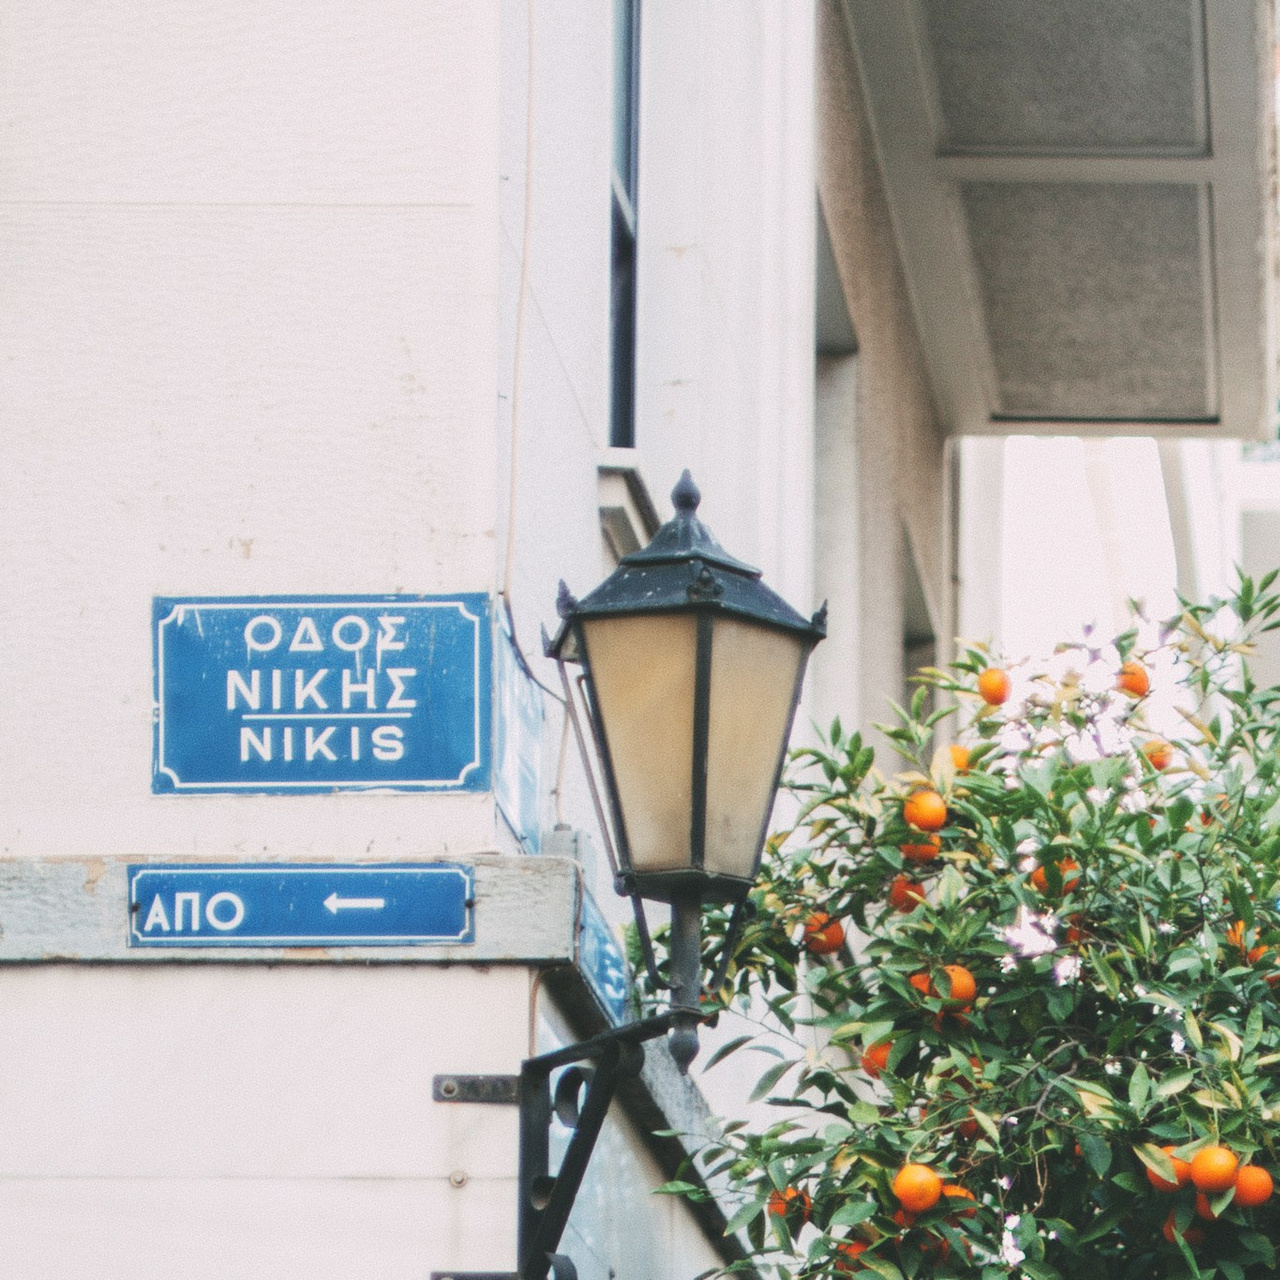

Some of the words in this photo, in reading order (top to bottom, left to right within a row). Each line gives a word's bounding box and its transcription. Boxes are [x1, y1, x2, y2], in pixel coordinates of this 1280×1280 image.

[244, 615, 405, 652] ΟΔΟΣ
[226, 668, 417, 710] ΝΙΚΗΣ
[240, 726, 404, 762] NIKIS
[144, 891, 244, 932] ΑΠΟ
